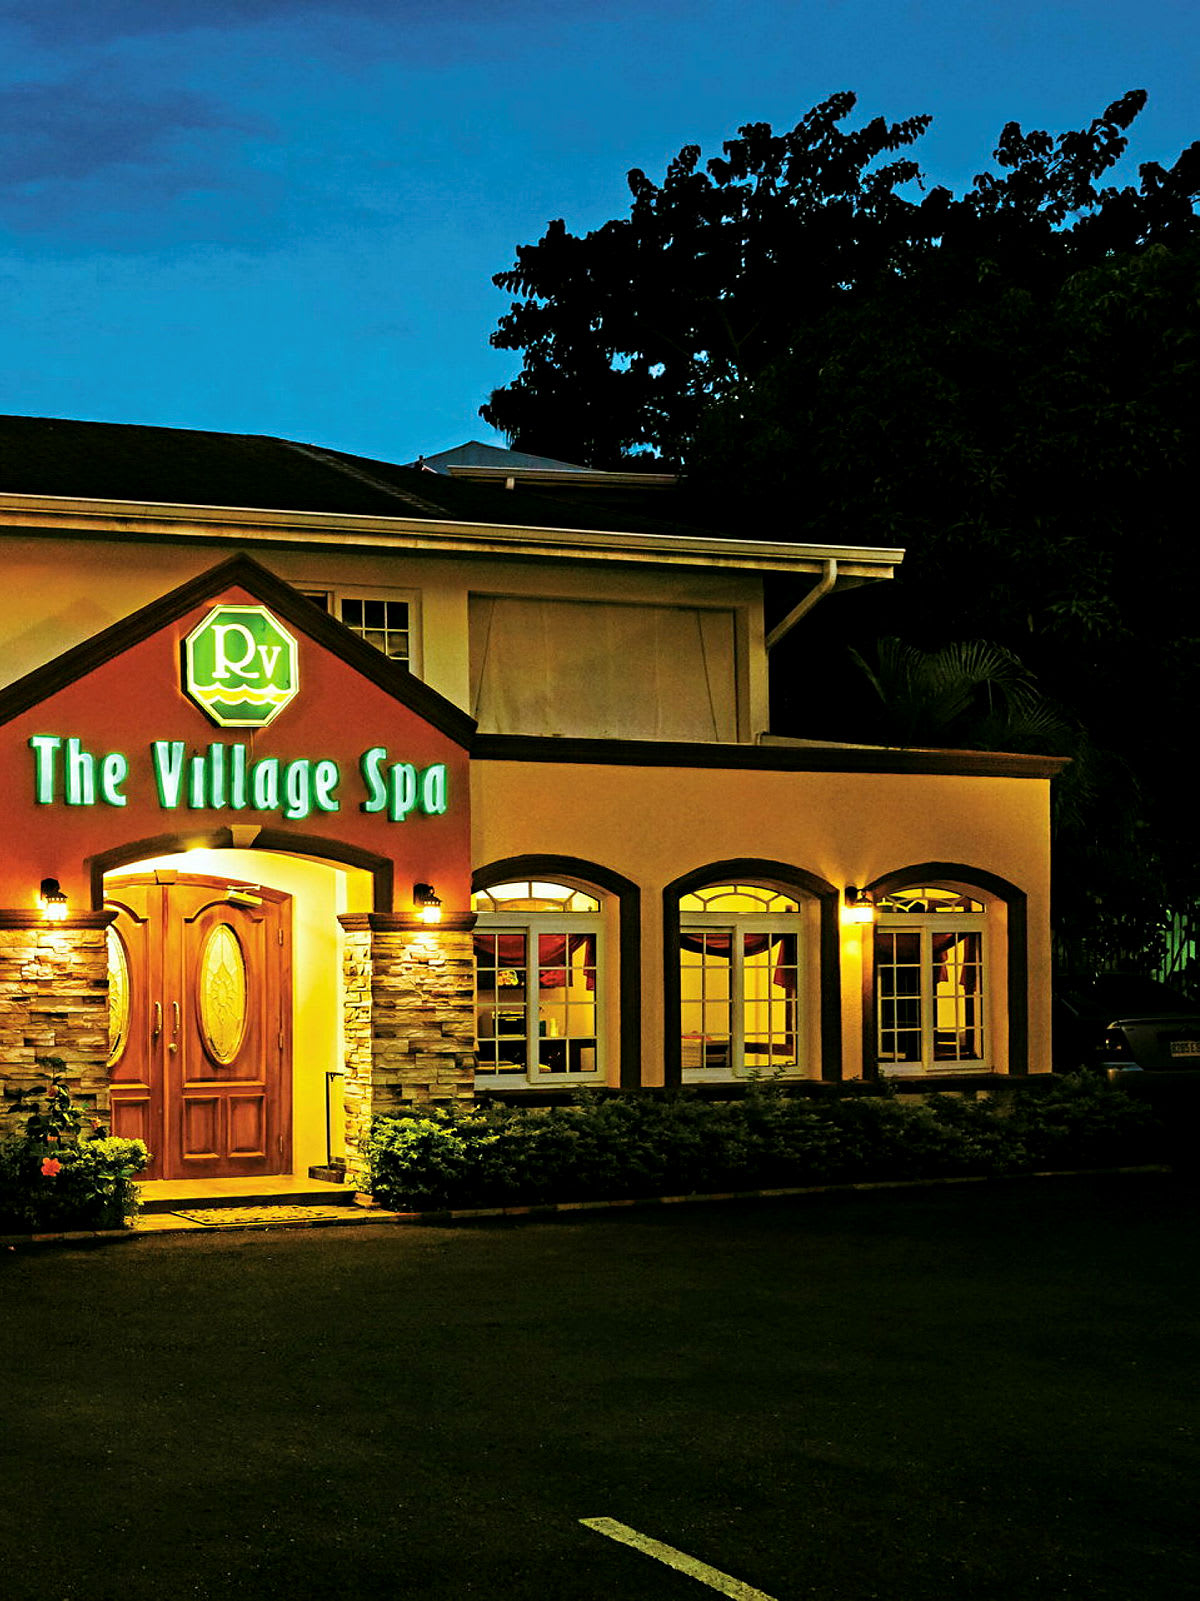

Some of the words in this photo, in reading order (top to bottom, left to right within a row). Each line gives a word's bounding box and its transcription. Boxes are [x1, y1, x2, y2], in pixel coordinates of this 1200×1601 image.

[30, 734, 128, 807] The
[153, 740, 340, 820] Village
[361, 747, 448, 822] Spa
